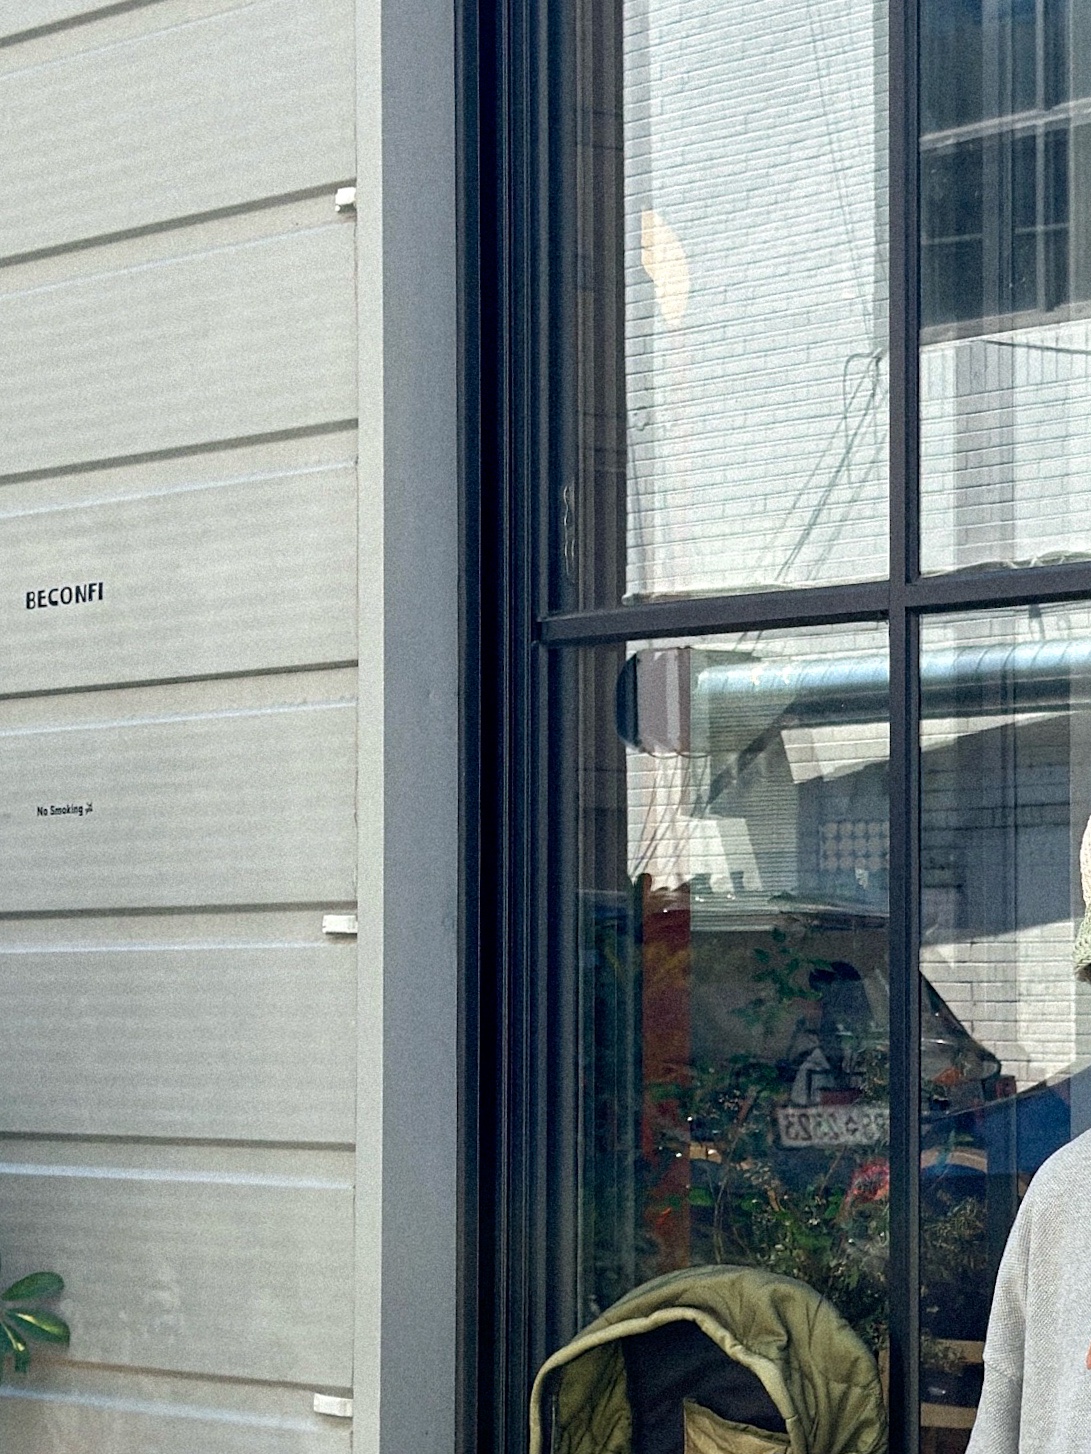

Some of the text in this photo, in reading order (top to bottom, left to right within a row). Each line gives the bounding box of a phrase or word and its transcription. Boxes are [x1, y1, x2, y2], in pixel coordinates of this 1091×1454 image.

[26, 582, 104, 609] BECONFI
[37, 804, 83, 817] No Smoking
